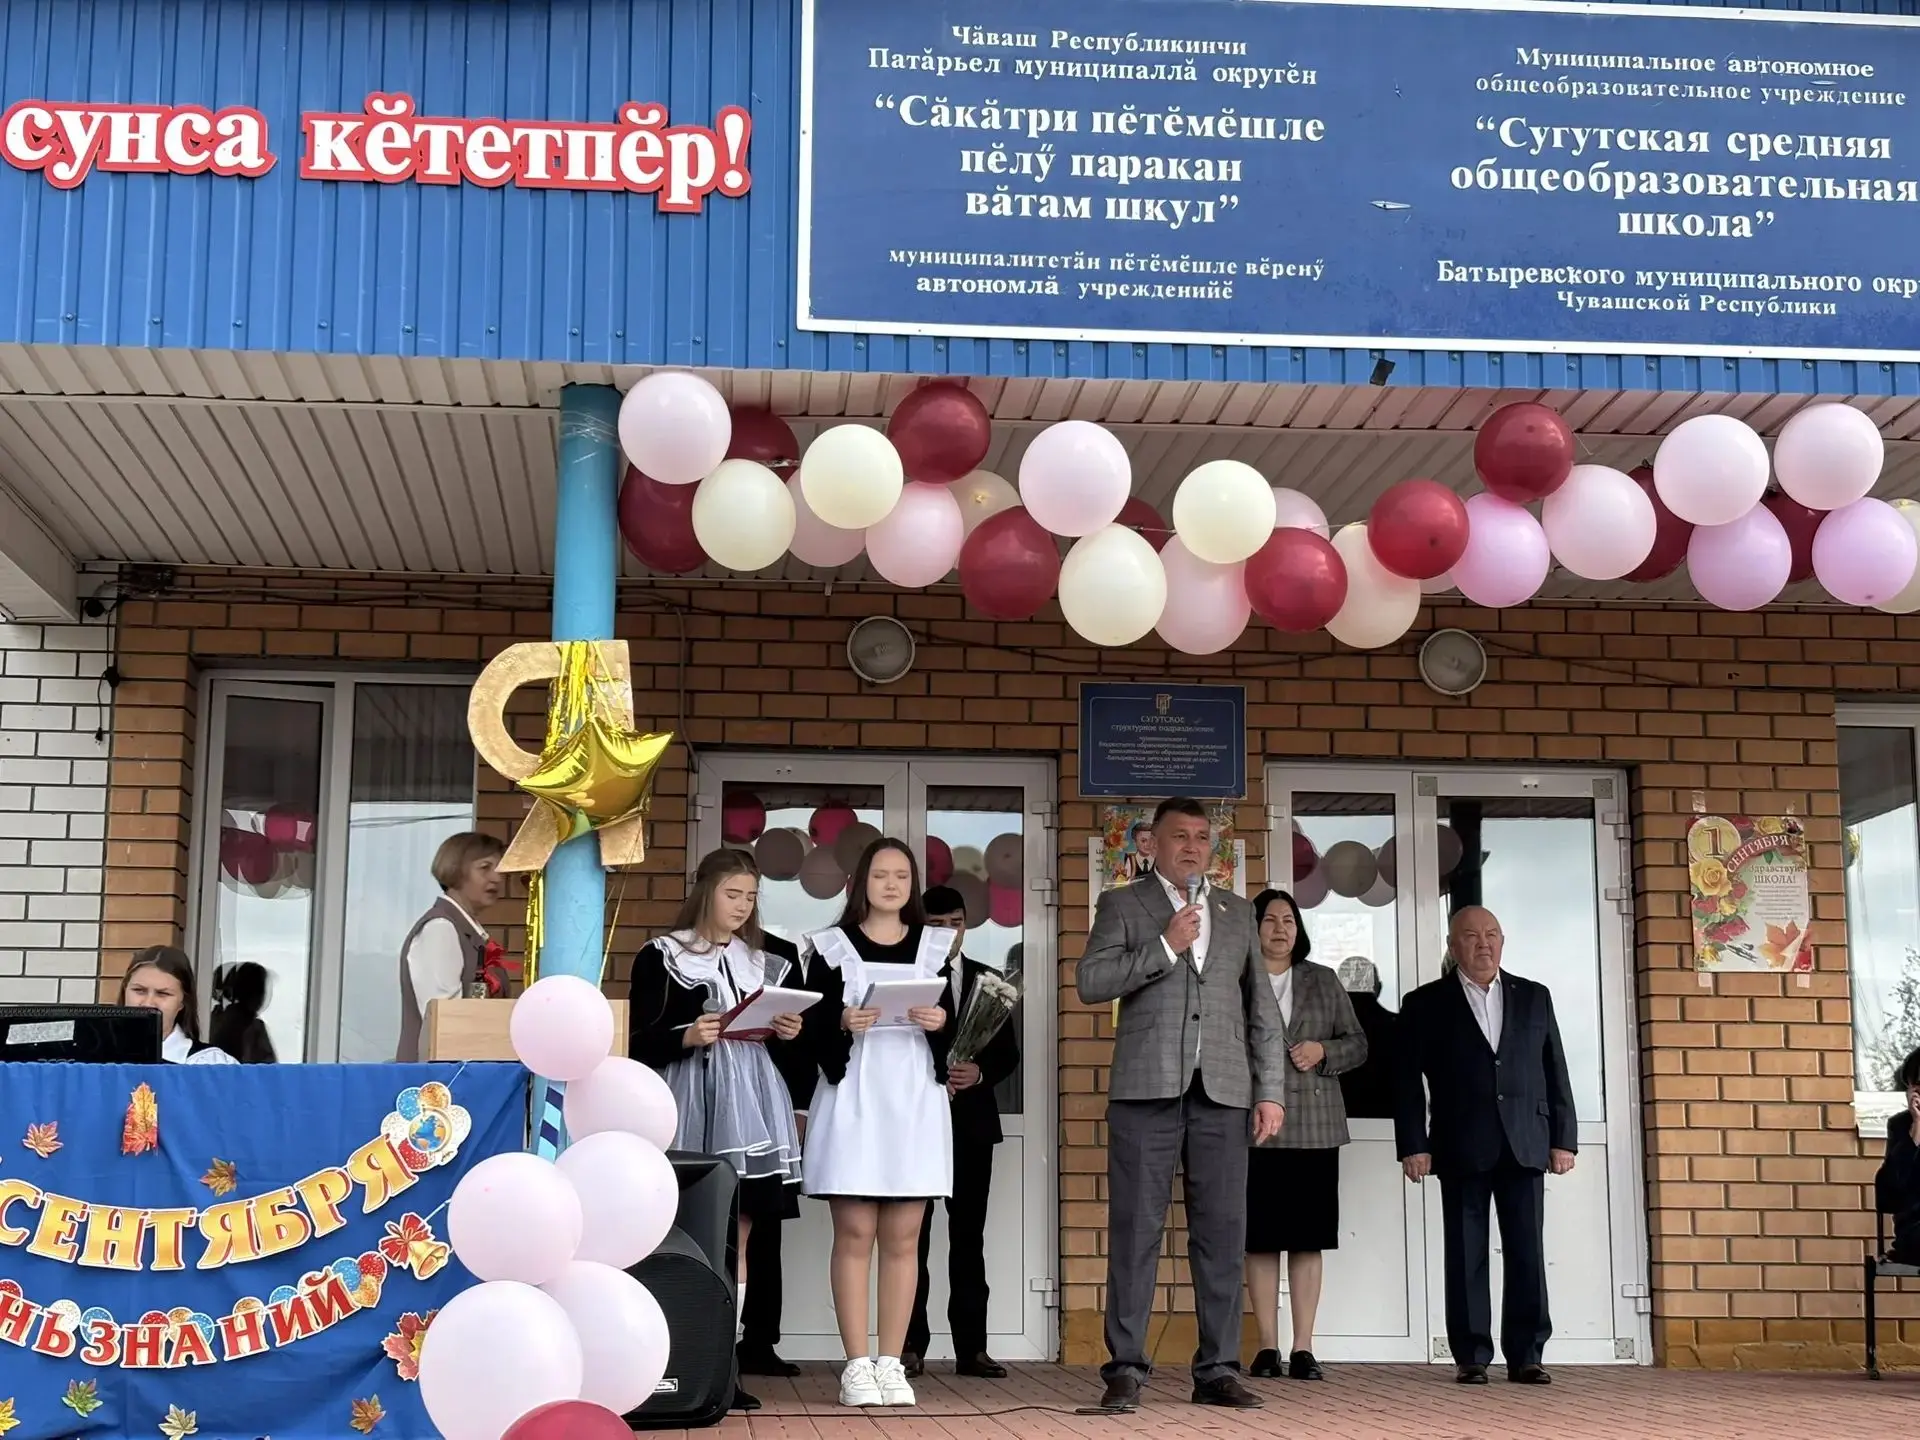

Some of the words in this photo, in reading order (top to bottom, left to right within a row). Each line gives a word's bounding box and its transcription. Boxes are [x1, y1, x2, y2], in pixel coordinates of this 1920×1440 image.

[1050, 30, 1247, 56] Республикинчи
[1516, 47, 1716, 72] Муниципальное
[1727, 59, 1874, 78] автономное
[1476, 72, 1751, 100] общеобразовательное
[1760, 87, 1906, 106] учреждение
[3, 105, 270, 187] сунса
[1726, 132, 1892, 162] средняя
[1070, 154, 1242, 185] паракан
[1450, 156, 1919, 202] общеобразовательная
[1437, 259, 1626, 289] Батыревского
[1635, 270, 1862, 298] муниципального
[1872, 276, 1920, 299] окр
[1557, 290, 1690, 313] Чувашской
[1699, 294, 1837, 317] Республики
[1703, 826, 1725, 858] 1
[1726, 834, 1790, 873] СЕНТЯБРЯ
[1754, 874, 1797, 884] ШКОЛА!
[0, 1134, 419, 1272] СЕНТЯБРЯ
